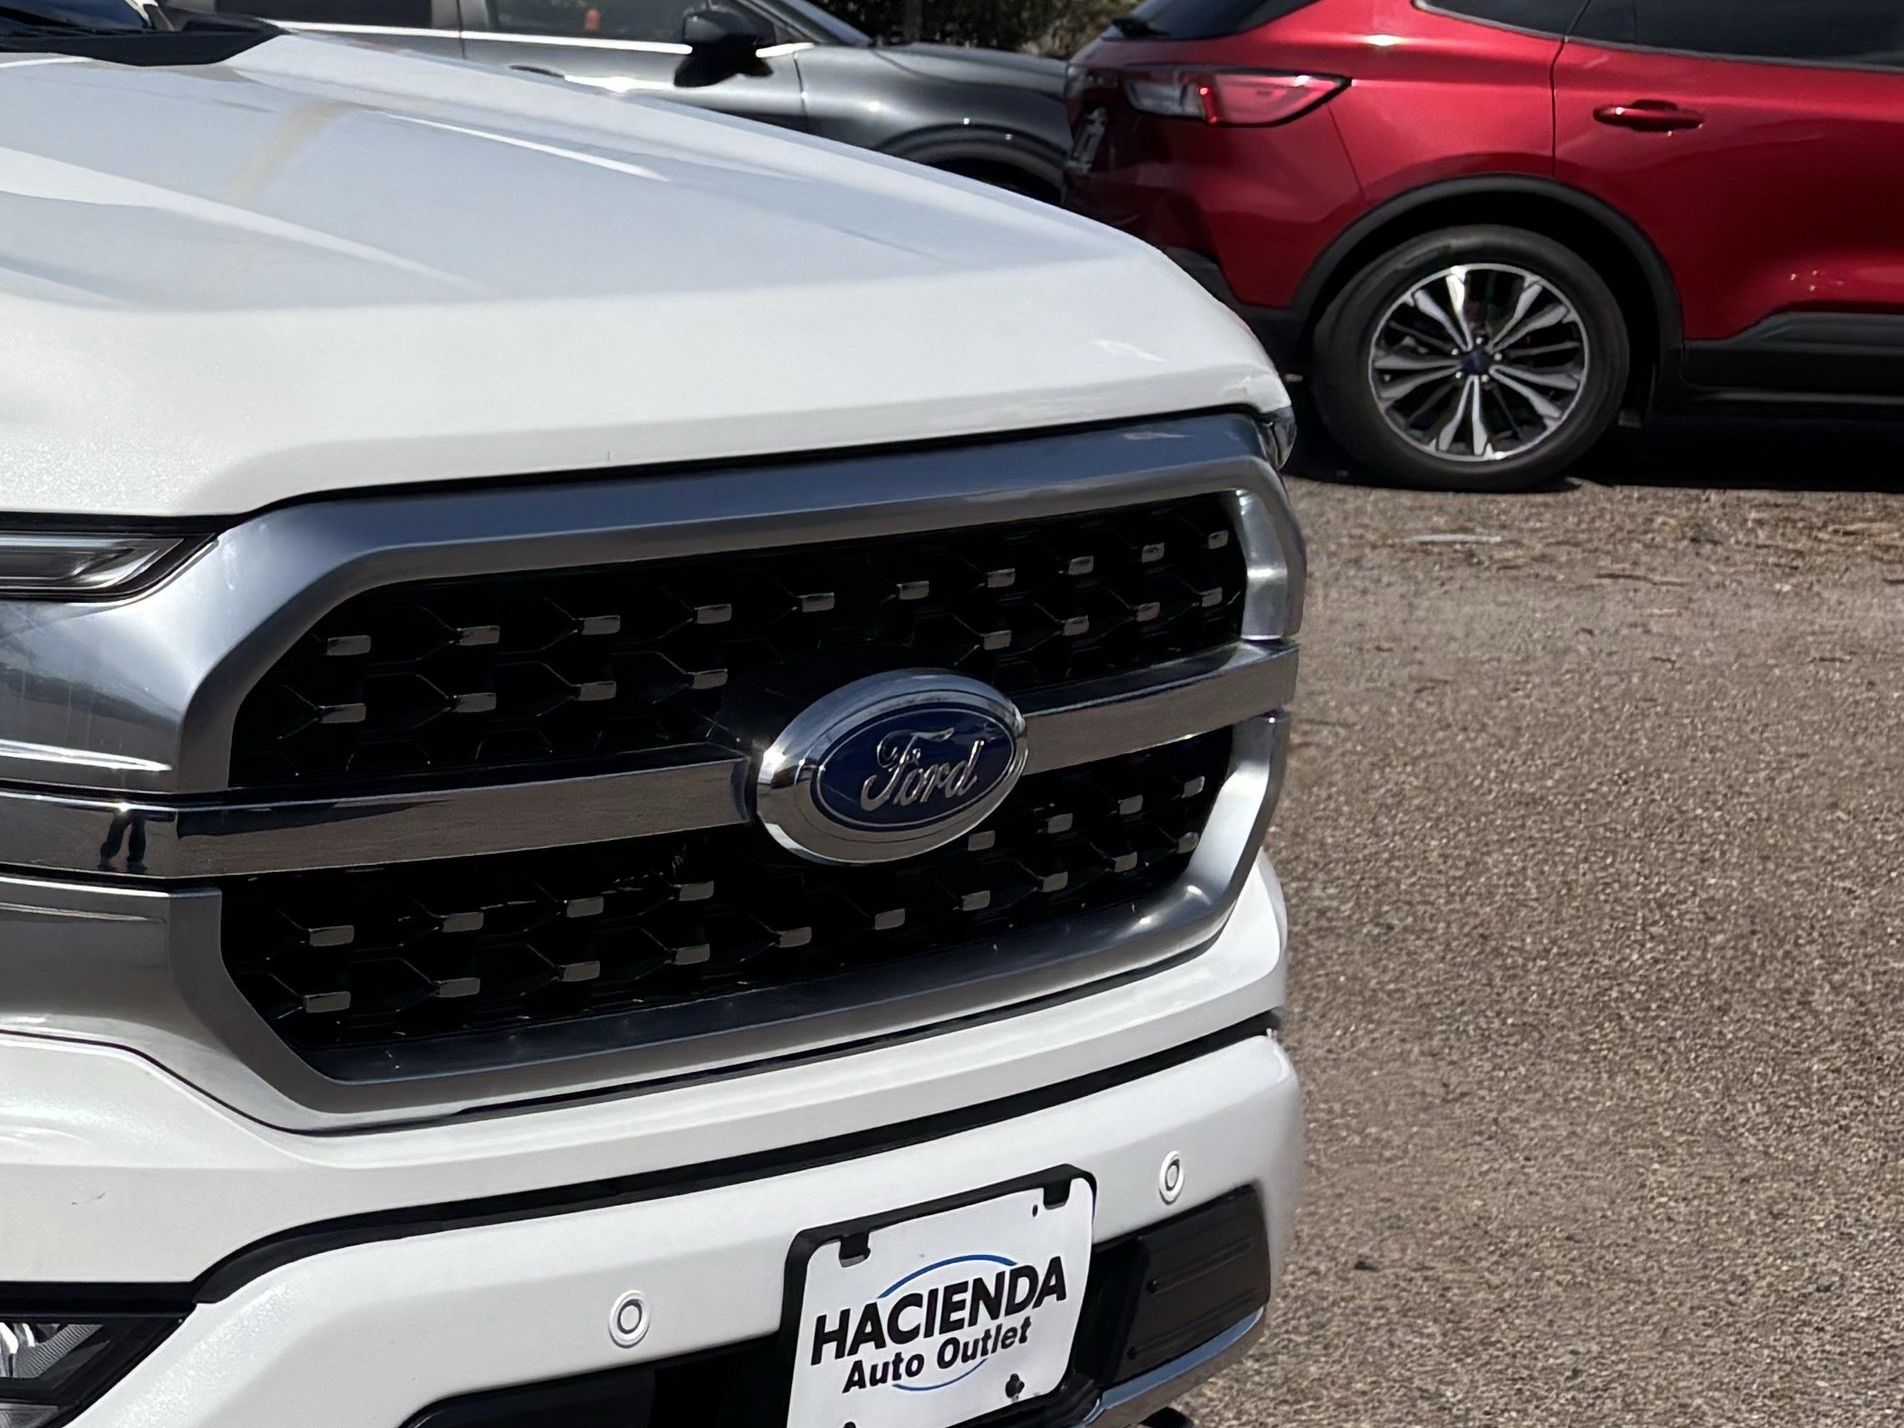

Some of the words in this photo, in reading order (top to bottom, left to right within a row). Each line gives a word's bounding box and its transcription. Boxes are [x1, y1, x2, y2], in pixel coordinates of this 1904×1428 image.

[859, 726, 985, 812] Ford
[810, 1256, 1067, 1365] HACIENDA
[842, 1349, 925, 1393] Auto
[936, 1316, 1033, 1371] Outlet
